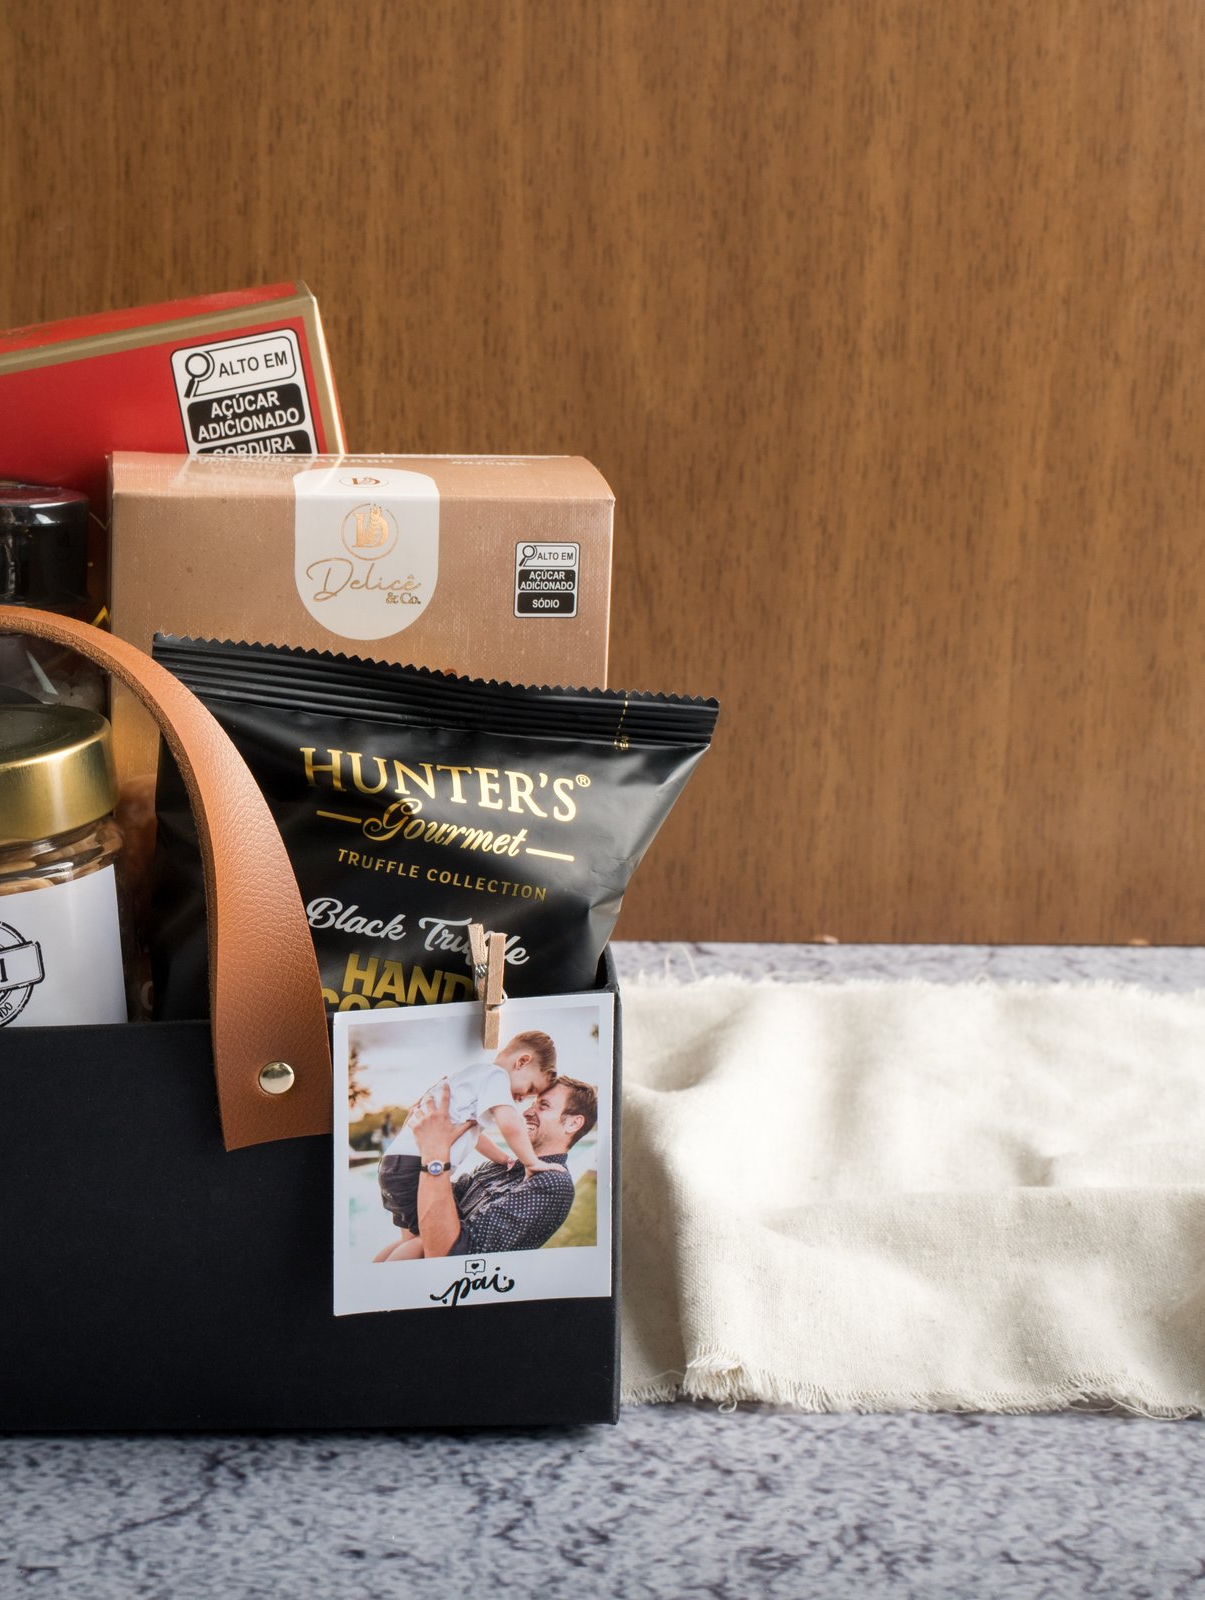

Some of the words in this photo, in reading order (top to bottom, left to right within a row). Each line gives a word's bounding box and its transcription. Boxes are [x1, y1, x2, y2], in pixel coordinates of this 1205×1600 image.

[218, 356, 260, 378] ALTO
[263, 350, 289, 369] EM
[210, 390, 281, 419] AÇÚCAR
[197, 407, 300, 442] ADICIONADO
[536, 551, 560, 561] ALTO
[561, 552, 574, 561] EM
[519, 581, 574, 590] ADICIONADO
[528, 569, 566, 582] AÇÚCAR
[531, 597, 561, 609] SÓDIO
[362, 797, 529, 857] Gourmet
[337, 849, 420, 879] TRUFFLE
[426, 868, 547, 901] COLLECTION
[305, 897, 407, 941] Black
[418, 917, 530, 966] Trule
[342, 952, 475, 1006] HAND
